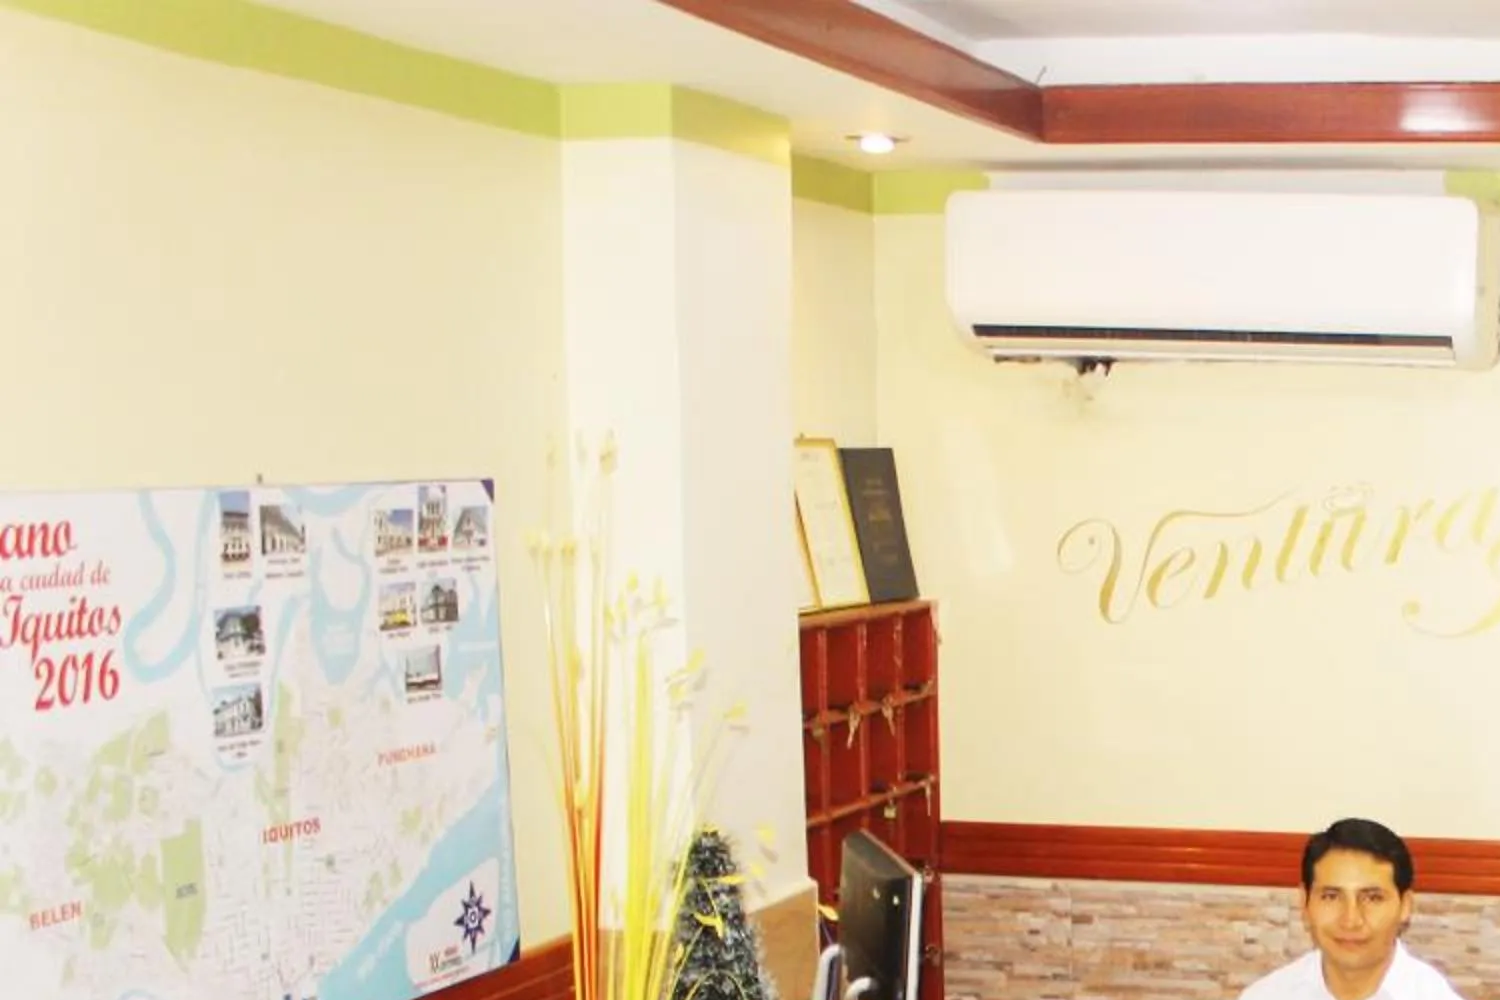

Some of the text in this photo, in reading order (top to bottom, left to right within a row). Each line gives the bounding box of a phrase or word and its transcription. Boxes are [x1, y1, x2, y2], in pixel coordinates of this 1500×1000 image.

[20, 561, 85, 592] ciudad
[90, 560, 111, 585] de
[1057, 487, 1500, 624] Ventura
[0, 594, 122, 668] Iquitos
[35, 649, 119, 711] 2016
[262, 817, 322, 844] IQUITOS
[29, 900, 82, 931] BELEN
